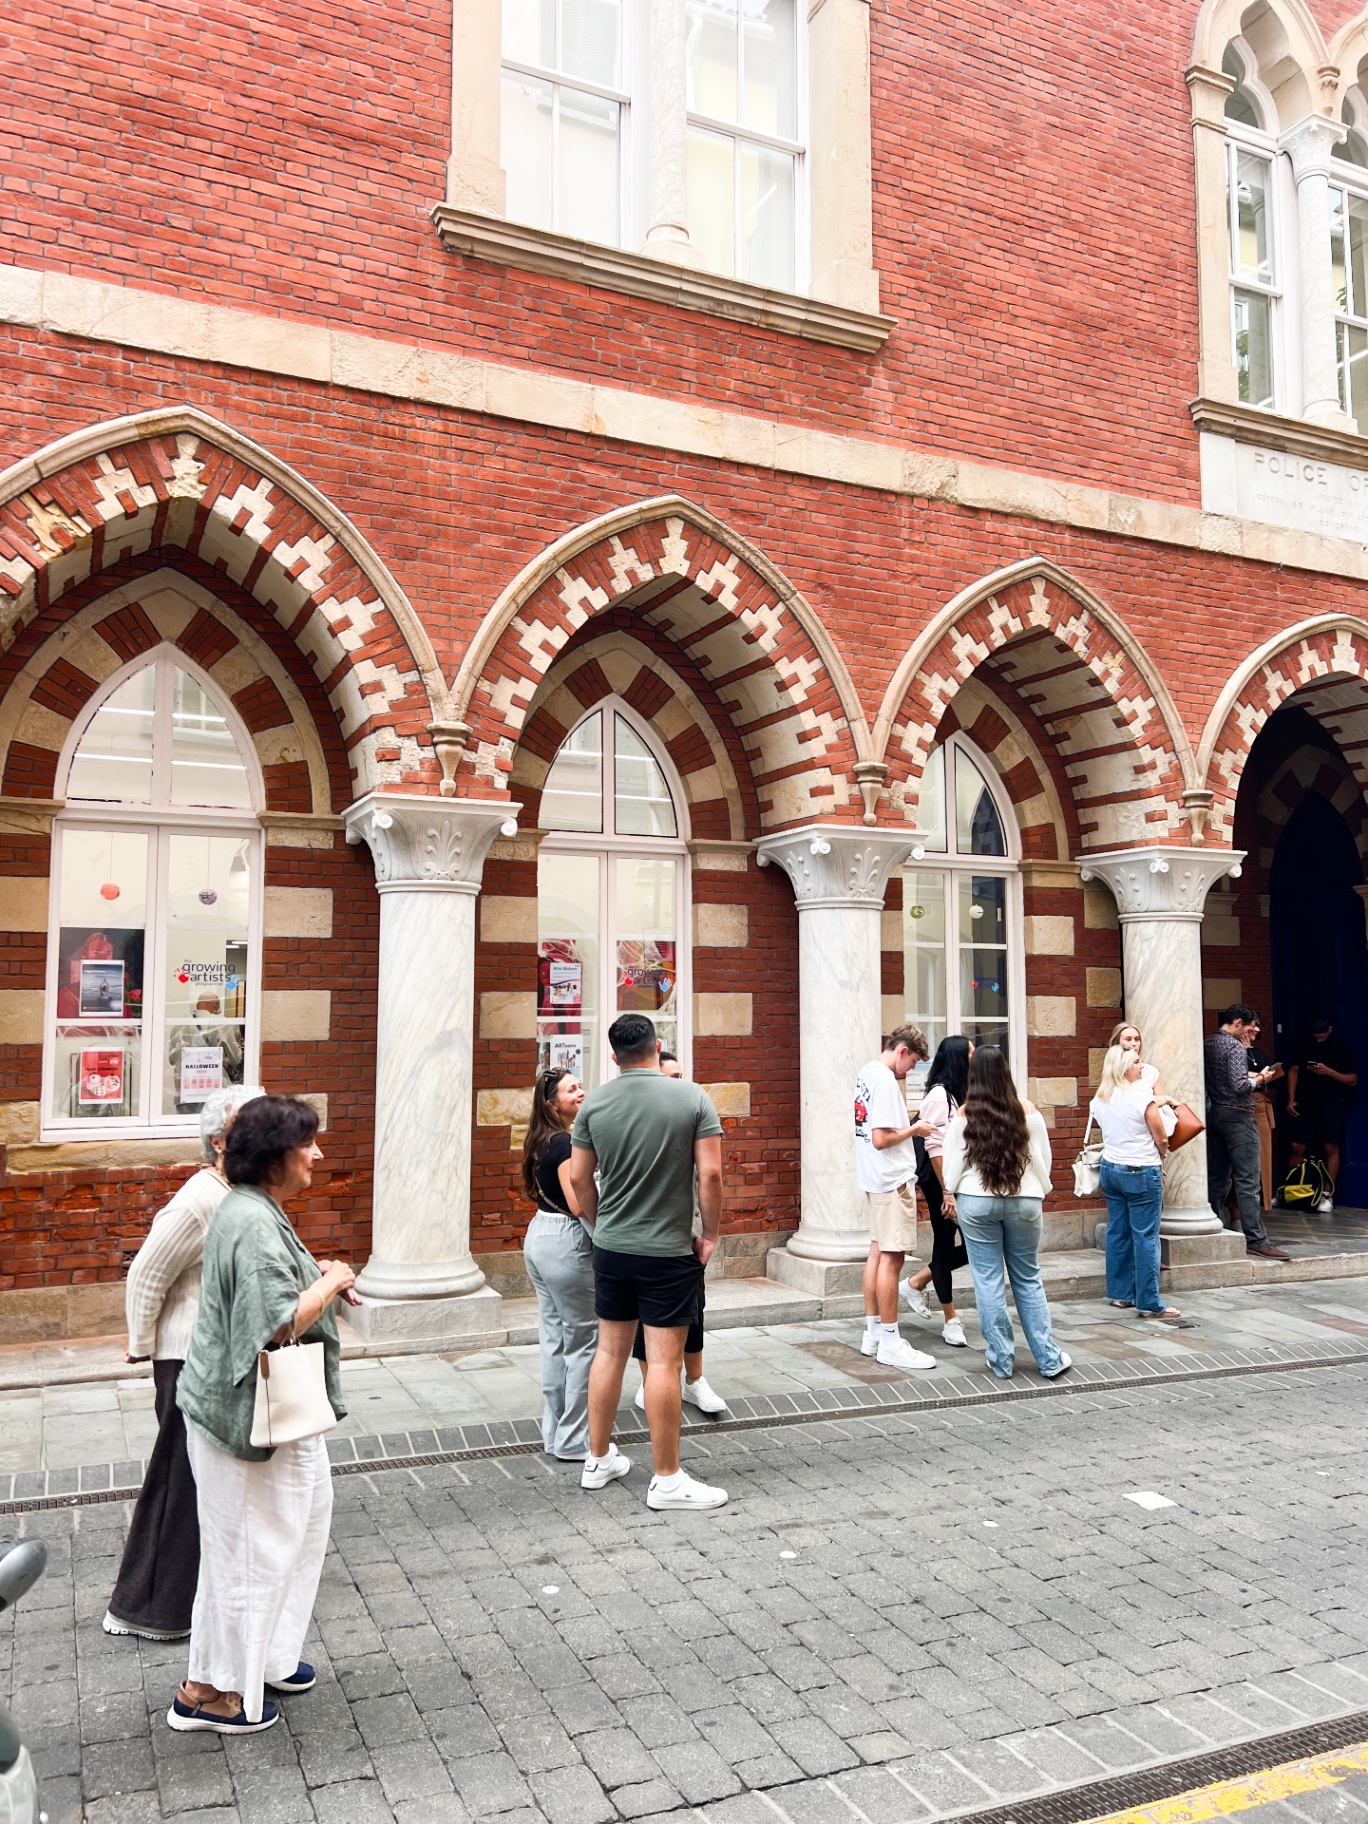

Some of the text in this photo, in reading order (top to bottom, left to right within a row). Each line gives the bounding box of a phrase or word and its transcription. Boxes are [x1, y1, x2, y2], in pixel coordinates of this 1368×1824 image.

[1254, 452, 1327, 485] POLICE
[1256, 493, 1288, 506] GENERAL
[182, 960, 236, 975] growing
[190, 971, 232, 982] artists
